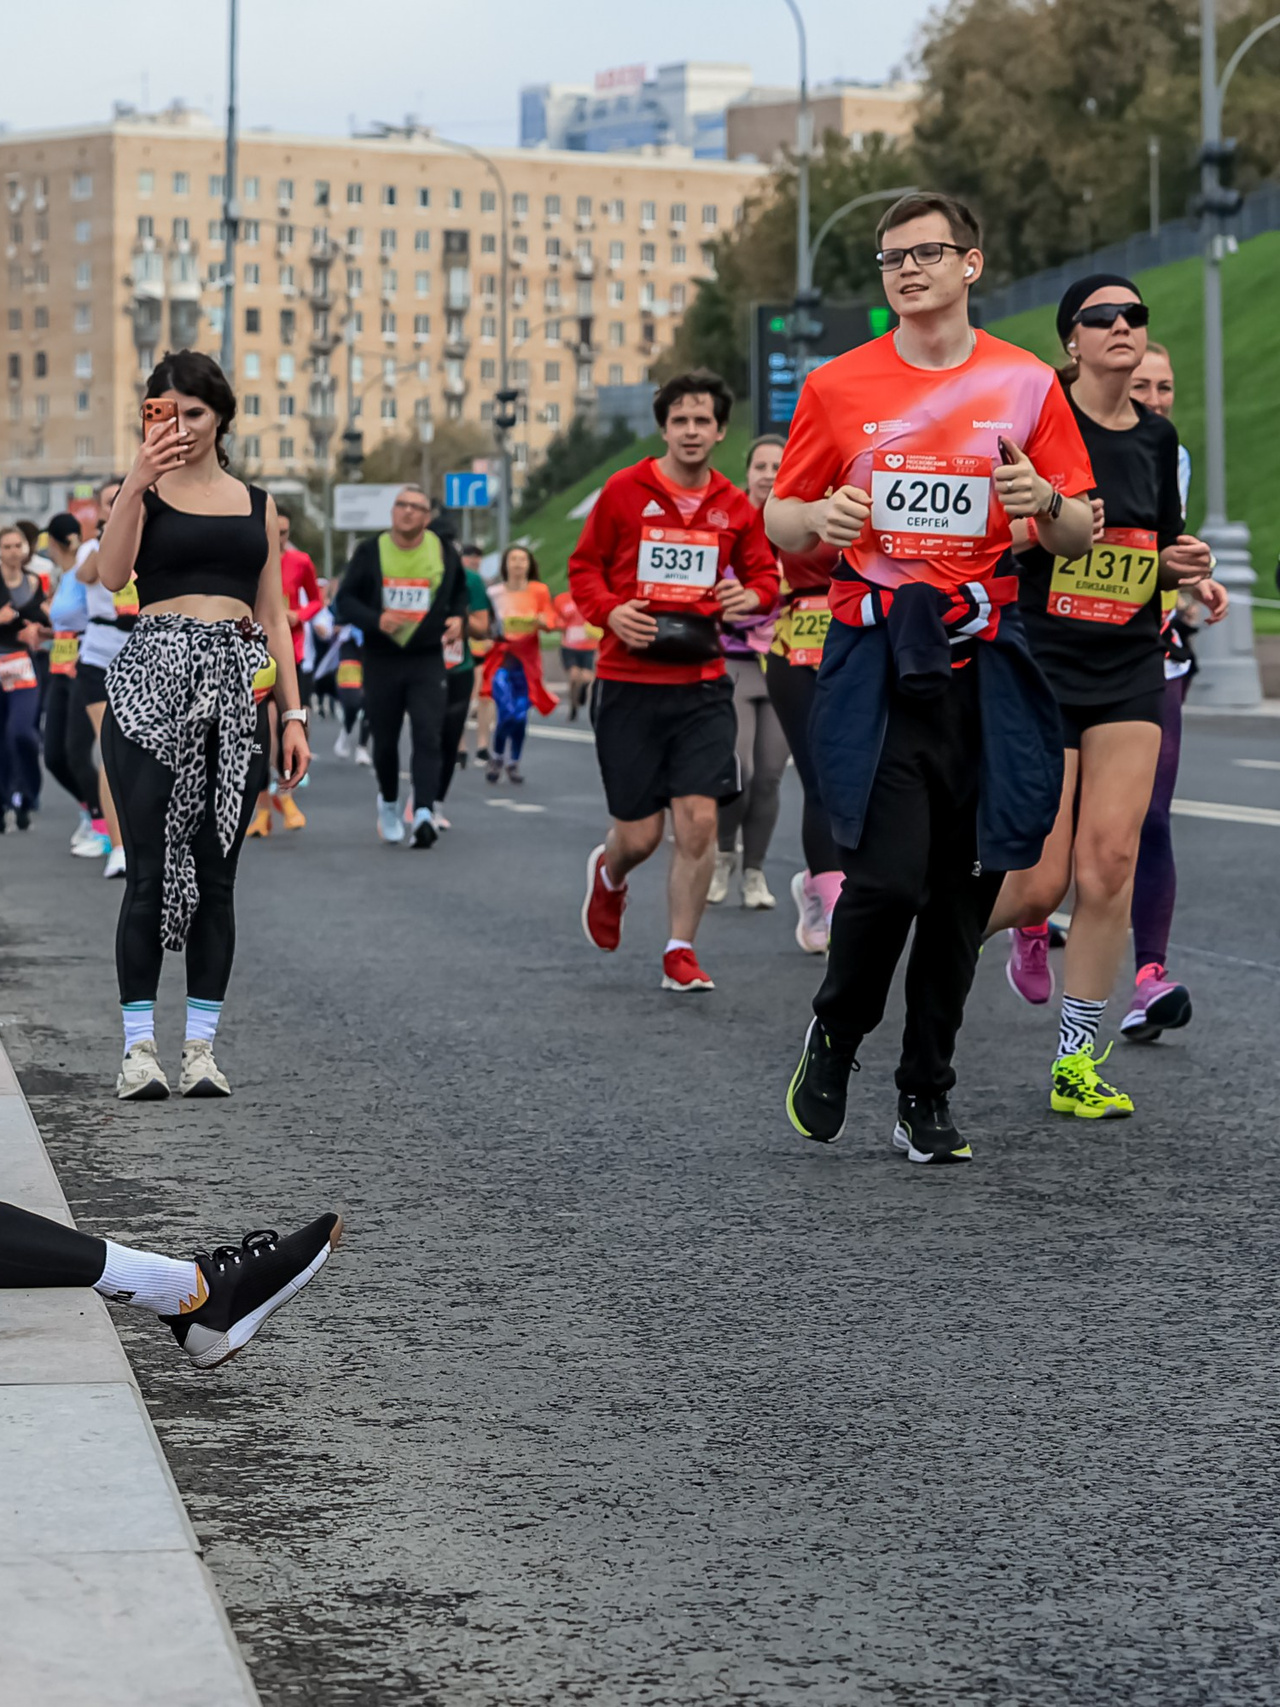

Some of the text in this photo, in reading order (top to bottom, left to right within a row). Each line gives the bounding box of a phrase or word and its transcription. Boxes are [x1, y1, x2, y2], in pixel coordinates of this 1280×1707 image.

[972, 420, 1013, 430] bodycare
[886, 479, 972, 515] 6206
[907, 516, 949, 528] СЕРГЕЙ
[880, 534, 893, 554] G
[650, 546, 705, 572] 5331
[1075, 580, 1130, 595] ЕЛИЗАВЕТА
[1056, 596, 1072, 614] G
